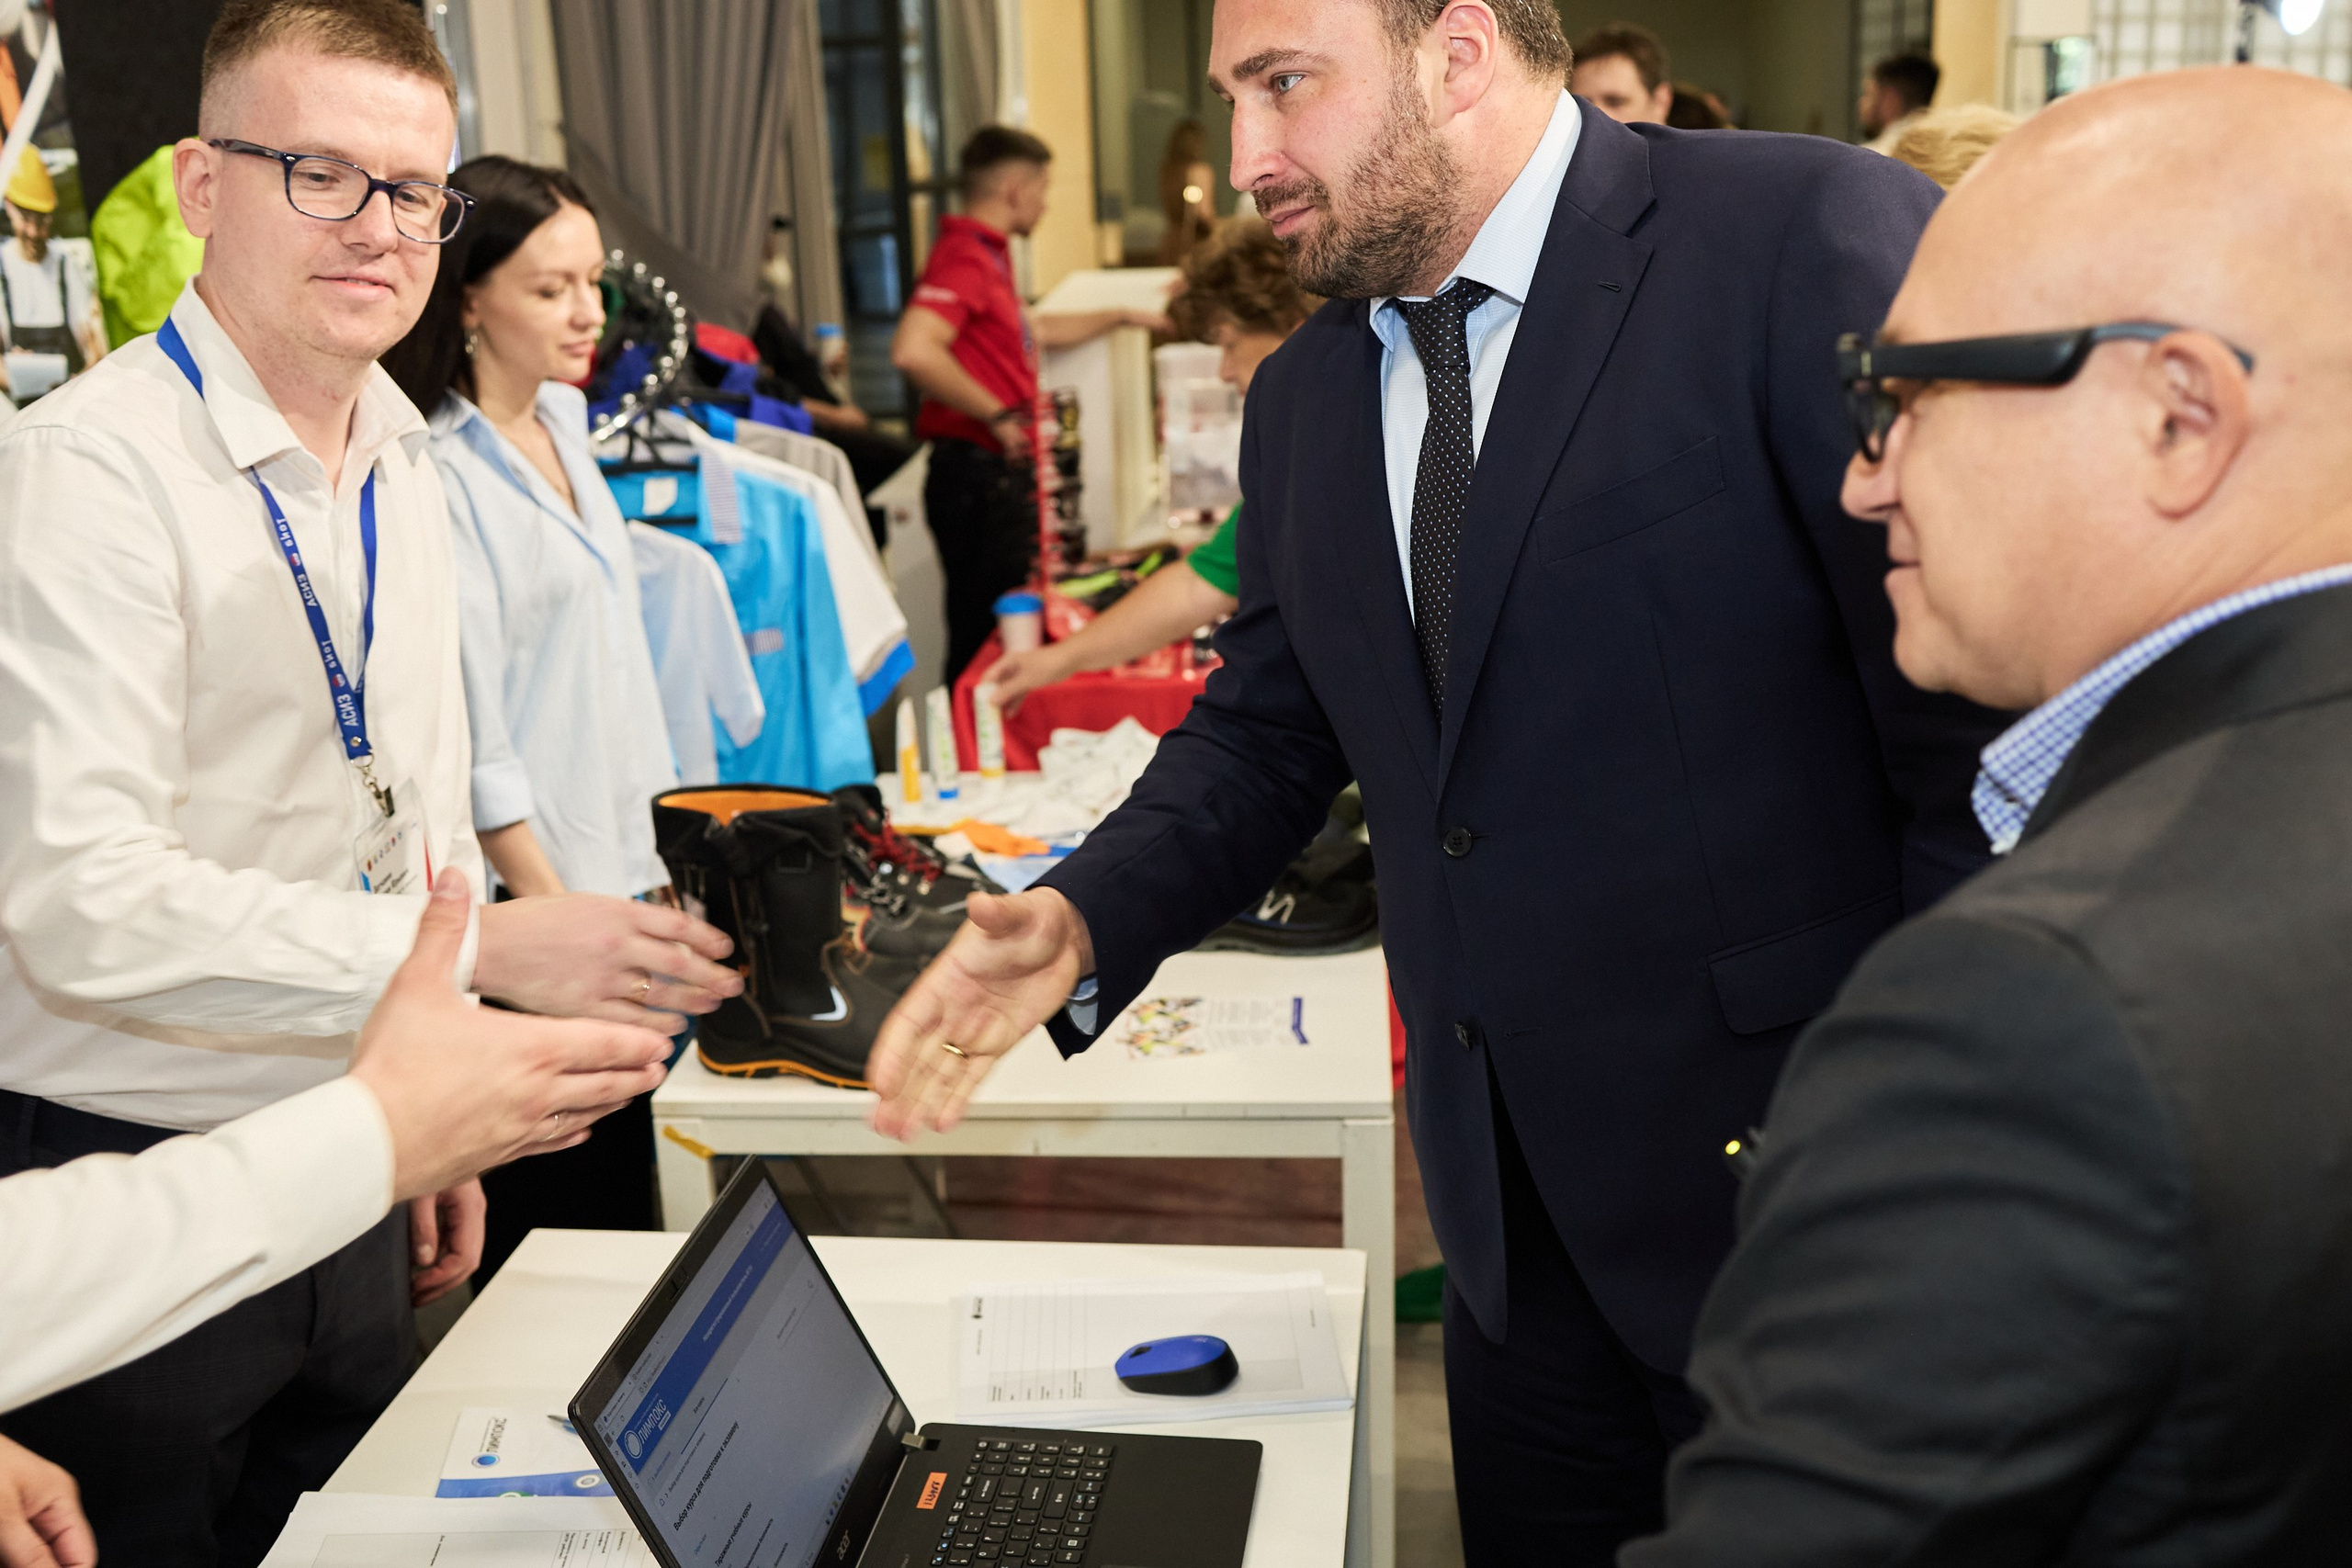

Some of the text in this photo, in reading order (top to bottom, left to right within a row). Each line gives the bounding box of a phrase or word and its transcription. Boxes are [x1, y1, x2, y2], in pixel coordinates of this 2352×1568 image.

[298, 574, 318, 607] АСИЗ
[334, 694, 357, 727] АСИЗ
[673, 1508, 688, 1531] Выбор
[685, 1492, 697, 1512] курса
[695, 1481, 704, 1495] для
[703, 1451, 722, 1483] подготовки
[722, 1421, 739, 1448] экзамену
[741, 1501, 752, 1519] курсы
[837, 1529, 851, 1561] acer
